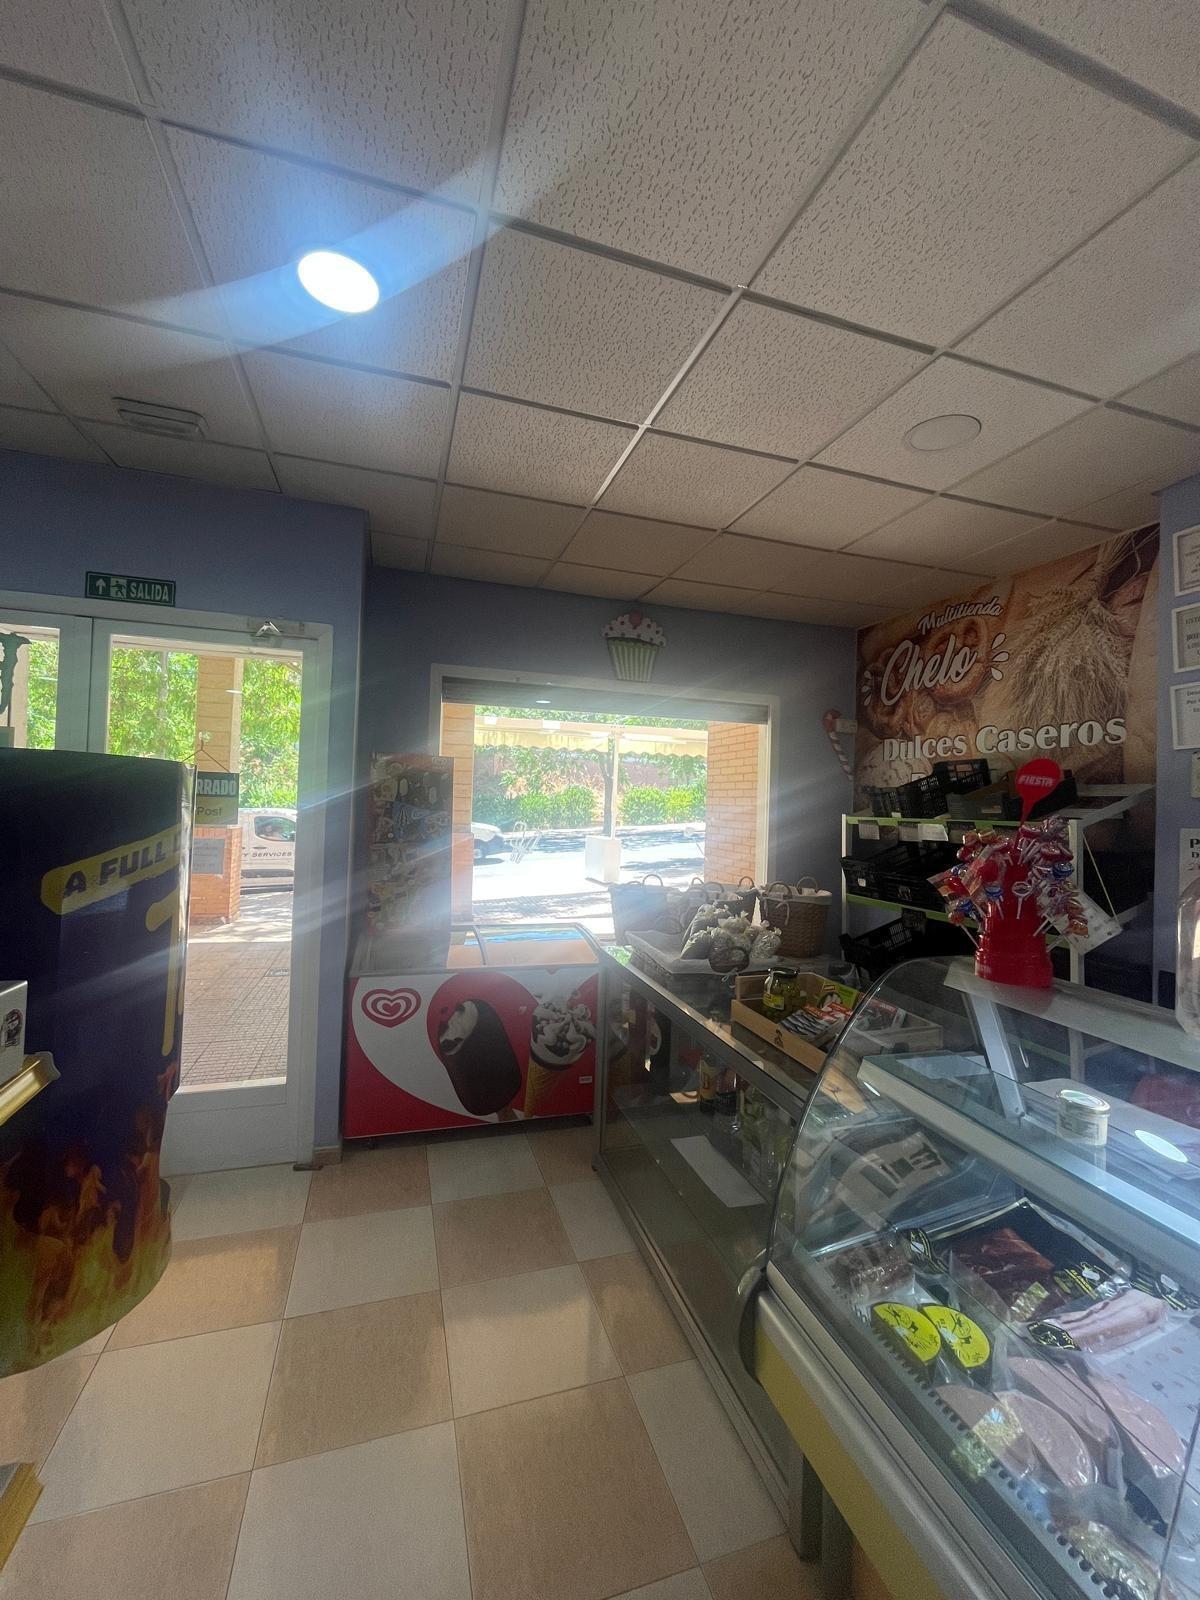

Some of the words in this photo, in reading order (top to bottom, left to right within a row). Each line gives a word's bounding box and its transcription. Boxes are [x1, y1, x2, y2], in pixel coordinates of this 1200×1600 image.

[129, 582, 169, 602] SALIDA
[918, 597, 1004, 635] Multitienda
[880, 634, 979, 706] Chelo
[883, 734, 967, 761] Dulces
[976, 717, 1128, 754] Caseros
[197, 779, 237, 796] RRADO
[1018, 775, 1054, 787] FIESTA
[63, 870, 87, 898] A
[99, 840, 165, 886] FULL
